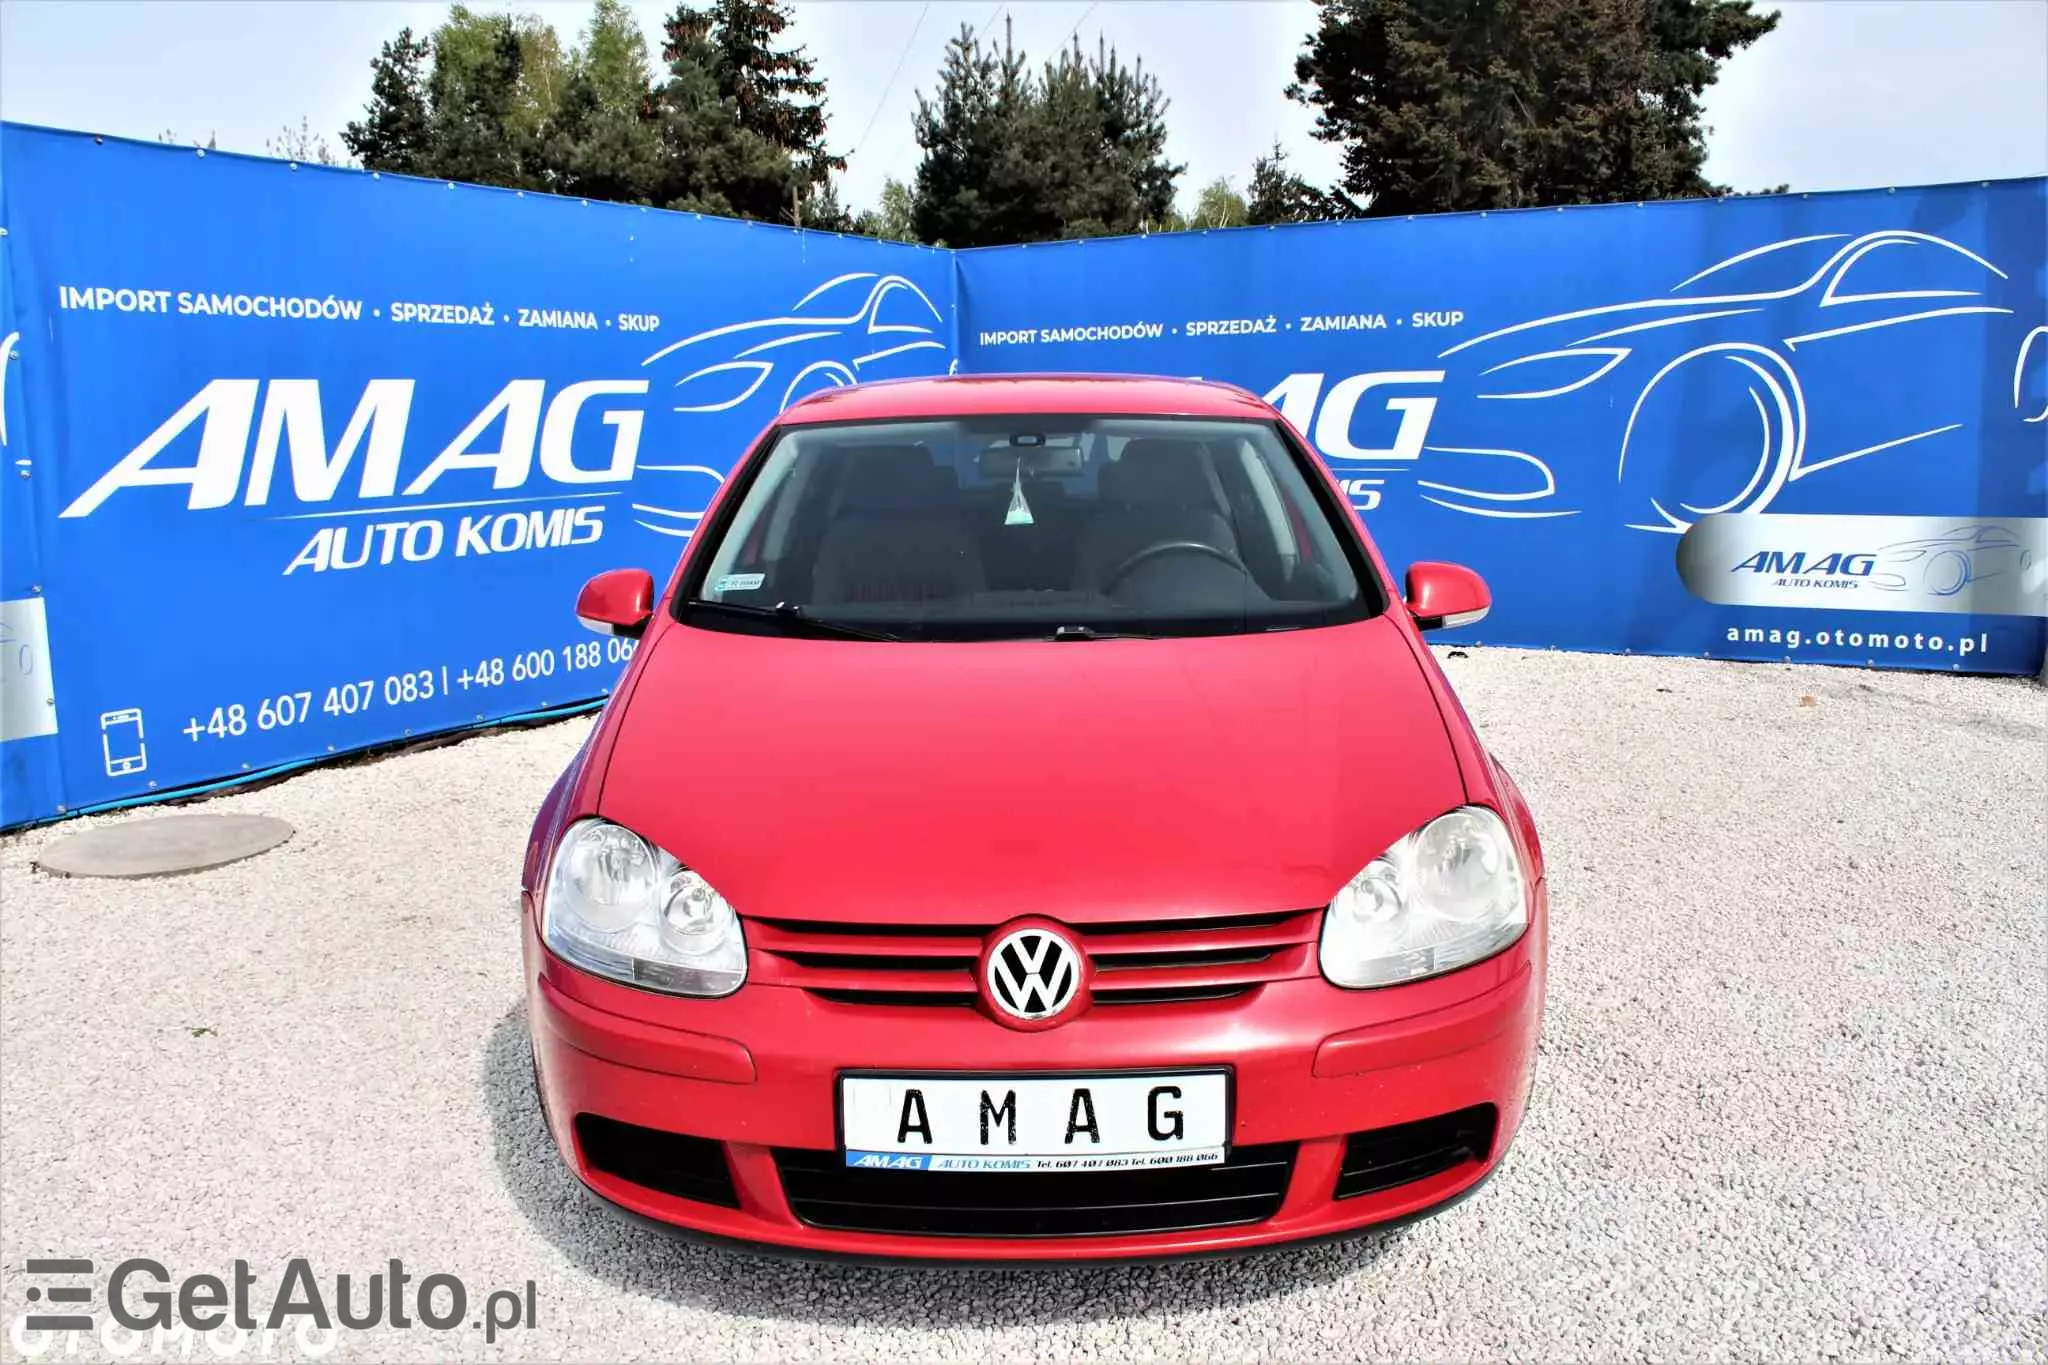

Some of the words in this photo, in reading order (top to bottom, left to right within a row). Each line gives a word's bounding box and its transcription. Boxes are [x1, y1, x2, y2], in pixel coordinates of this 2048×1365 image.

[59, 286, 172, 313] IMPORT
[177, 291, 363, 321] SAMOCHODÓW
[390, 301, 495, 326] SPRZEDAŻ
[517, 308, 598, 330] ZAMIANA
[618, 313, 660, 333] SKUP
[979, 328, 1038, 346] IMPORT
[1040, 321, 1164, 343] SAMOCHODÓW
[1186, 314, 1277, 336] SPRZEDAŻ
[1300, 314, 1387, 332] ZAMIANA
[1412, 310, 1464, 329] SKUP
[282, 517, 444, 576] AUTO
[455, 505, 606, 557] KOMIS
[1773, 578, 1811, 588] AUTO
[1813, 579, 1859, 589] KOMIS
[1727, 627, 1987, 656] amag.otomoto.pl
[183, 703, 247, 742] +48
[256, 691, 312, 730] 607
[323, 680, 374, 717] 407
[384, 670, 434, 705] 083
[457, 656, 505, 691] +48
[511, 648, 555, 681] 600
[562, 640, 602, 672] 188
[938, 1158, 979, 1169] AUTO
[982, 1158, 1032, 1169] KOMIS
